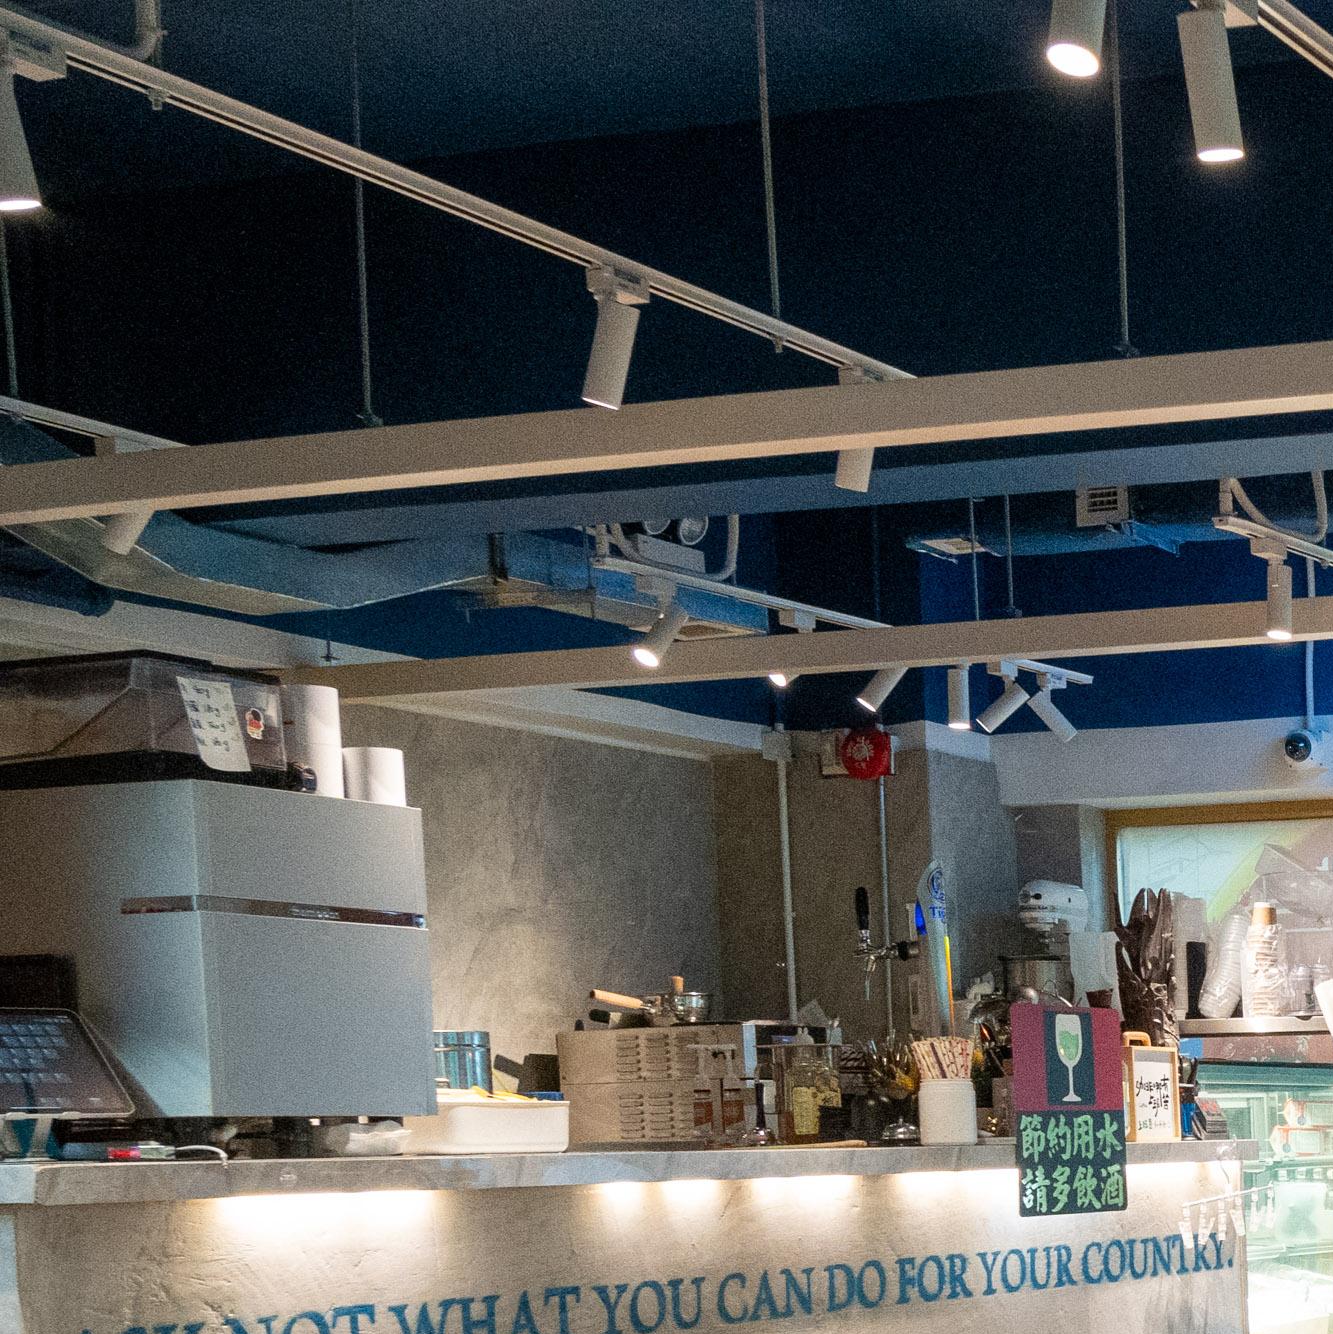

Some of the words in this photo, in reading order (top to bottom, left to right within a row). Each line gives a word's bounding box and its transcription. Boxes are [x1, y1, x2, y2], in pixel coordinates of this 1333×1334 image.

[1020, 1112, 1123, 1162] 節約用水
[1021, 1164, 1125, 1213] 請多飲酒
[717, 1266, 813, 1325] CAN
[827, 1259, 886, 1312] DO
[895, 1252, 968, 1305] FOR
[978, 1244, 1077, 1296] YOUR
